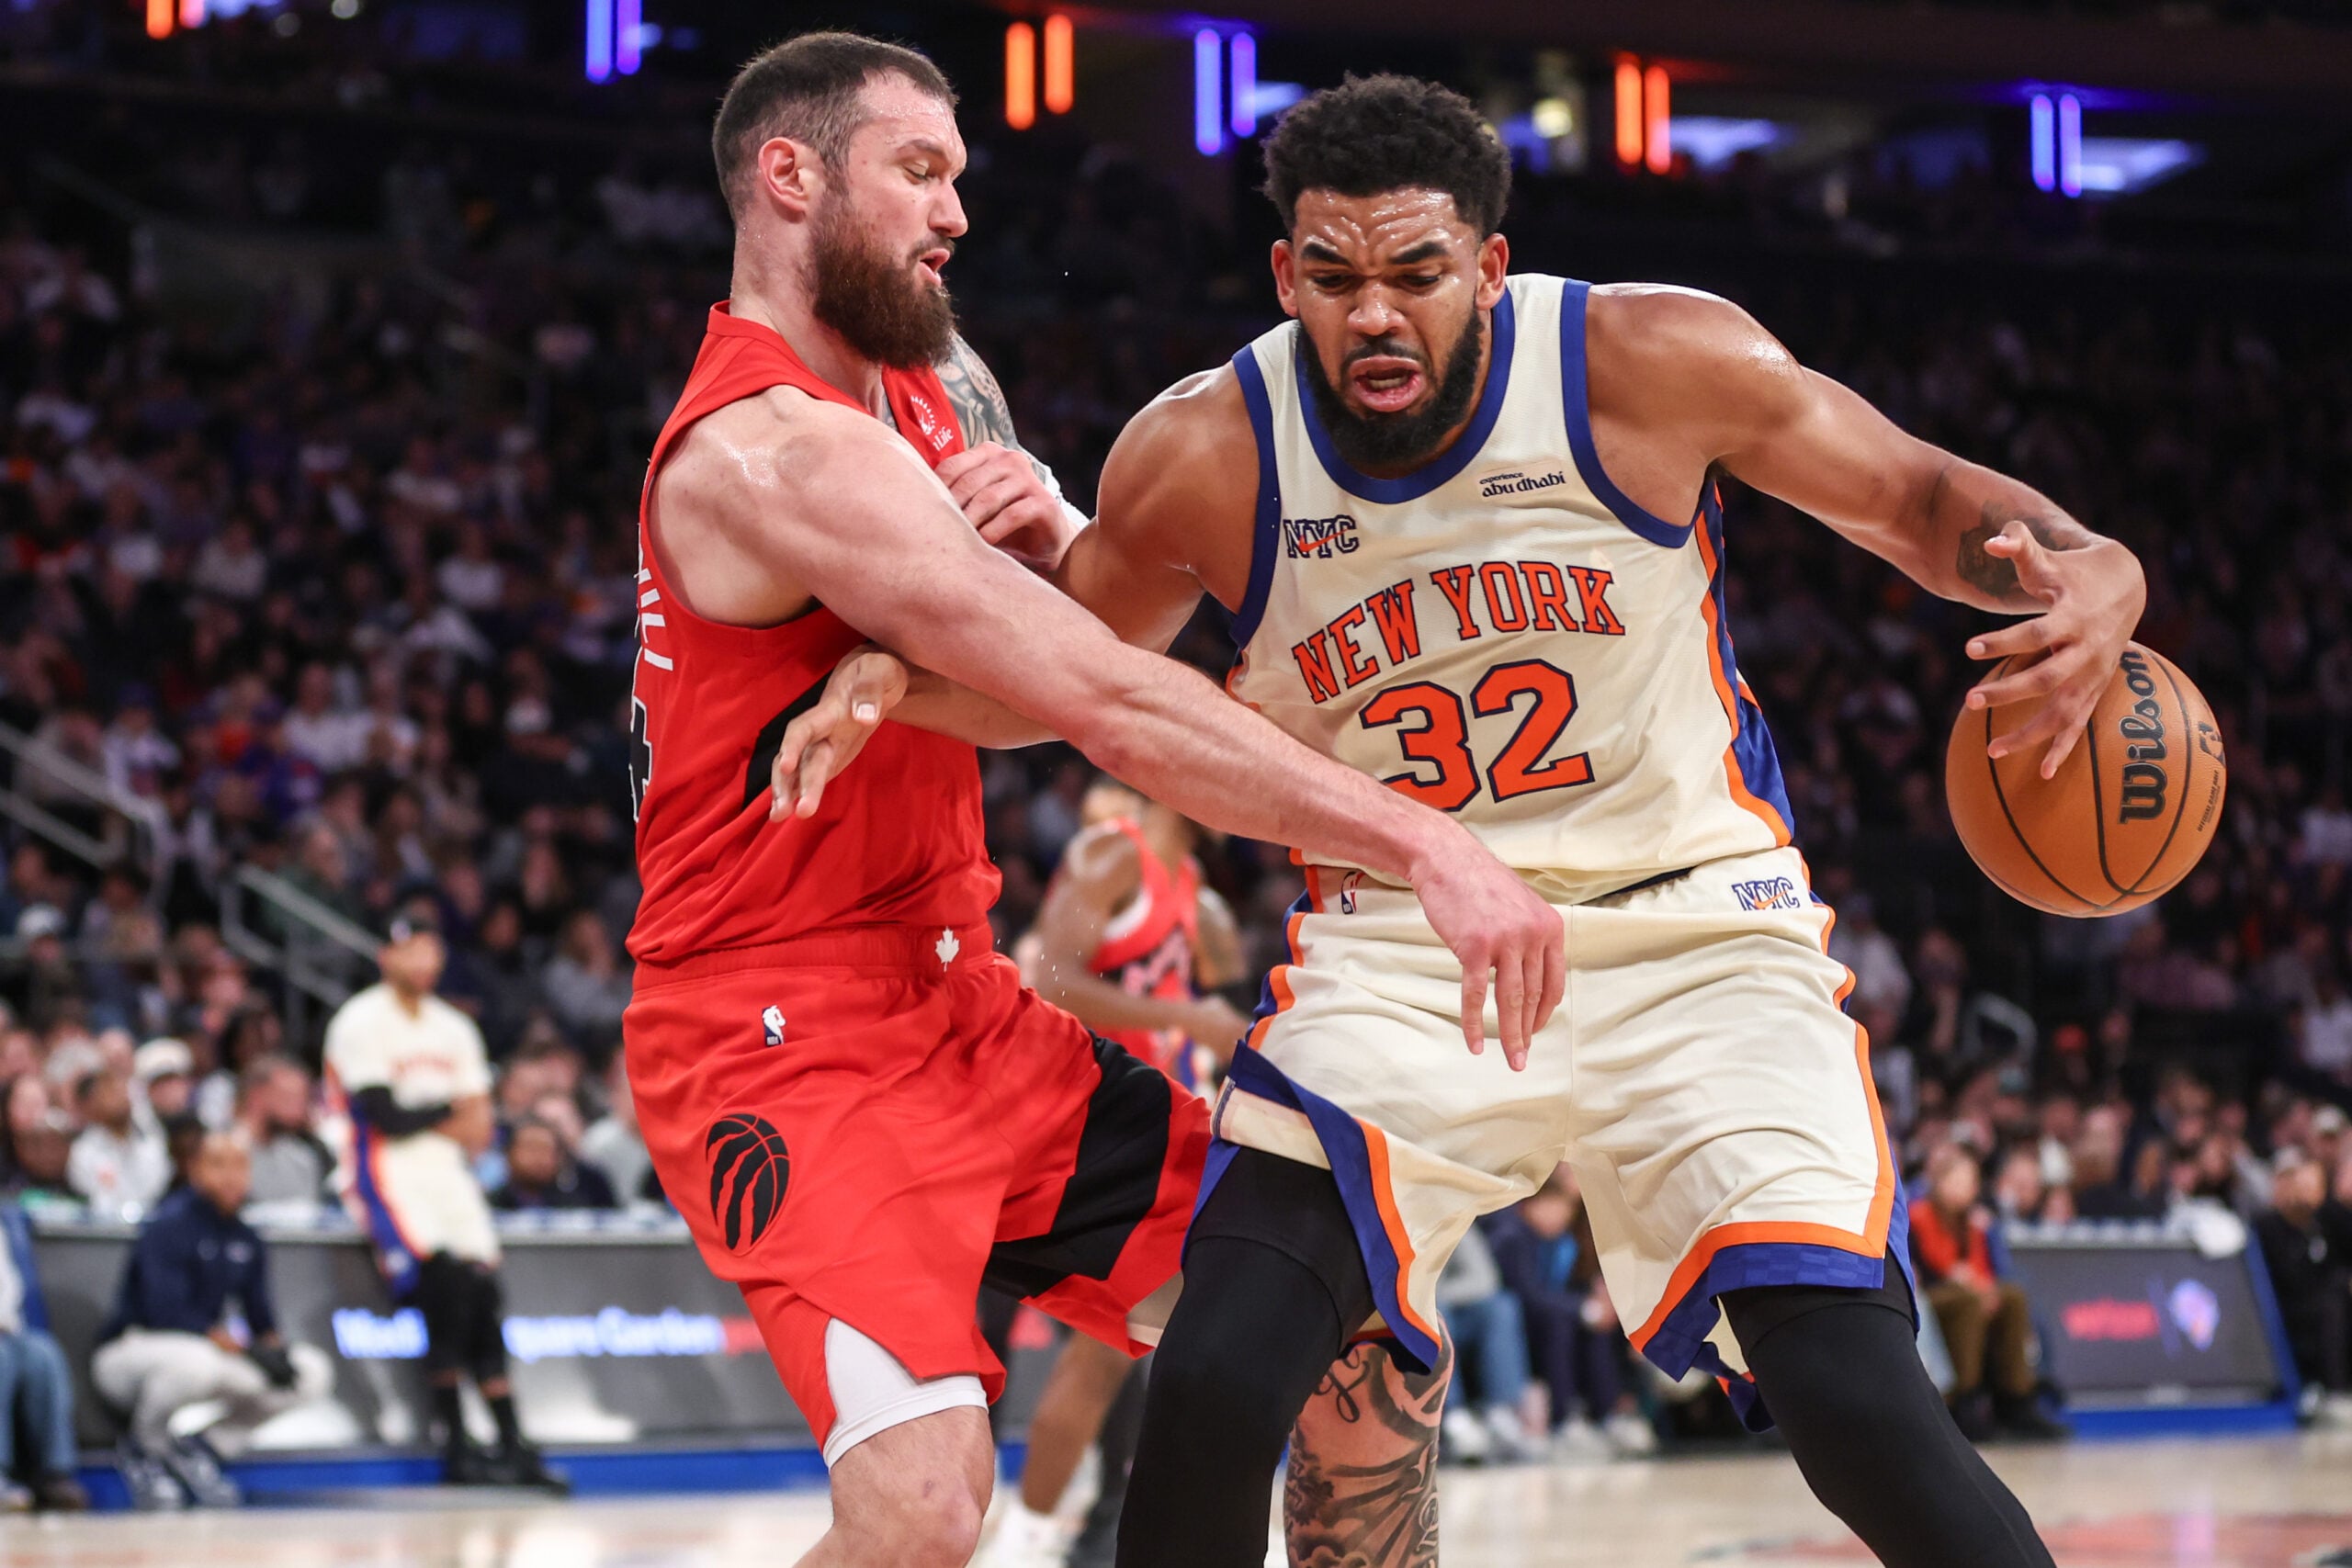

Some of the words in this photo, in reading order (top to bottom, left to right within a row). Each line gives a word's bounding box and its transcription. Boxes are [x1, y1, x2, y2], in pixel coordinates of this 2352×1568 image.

[1478, 471, 1524, 485] experience
[1482, 483, 1516, 498] abu
[1516, 470, 1566, 492] dhabi
[1283, 514, 1360, 558] NYC
[1291, 579, 1422, 705] NEW
[1430, 560, 1626, 640] YORK
[1358, 658, 1596, 812] 32
[2119, 650, 2167, 825] Wilson
[1731, 876, 1801, 911] NYC
